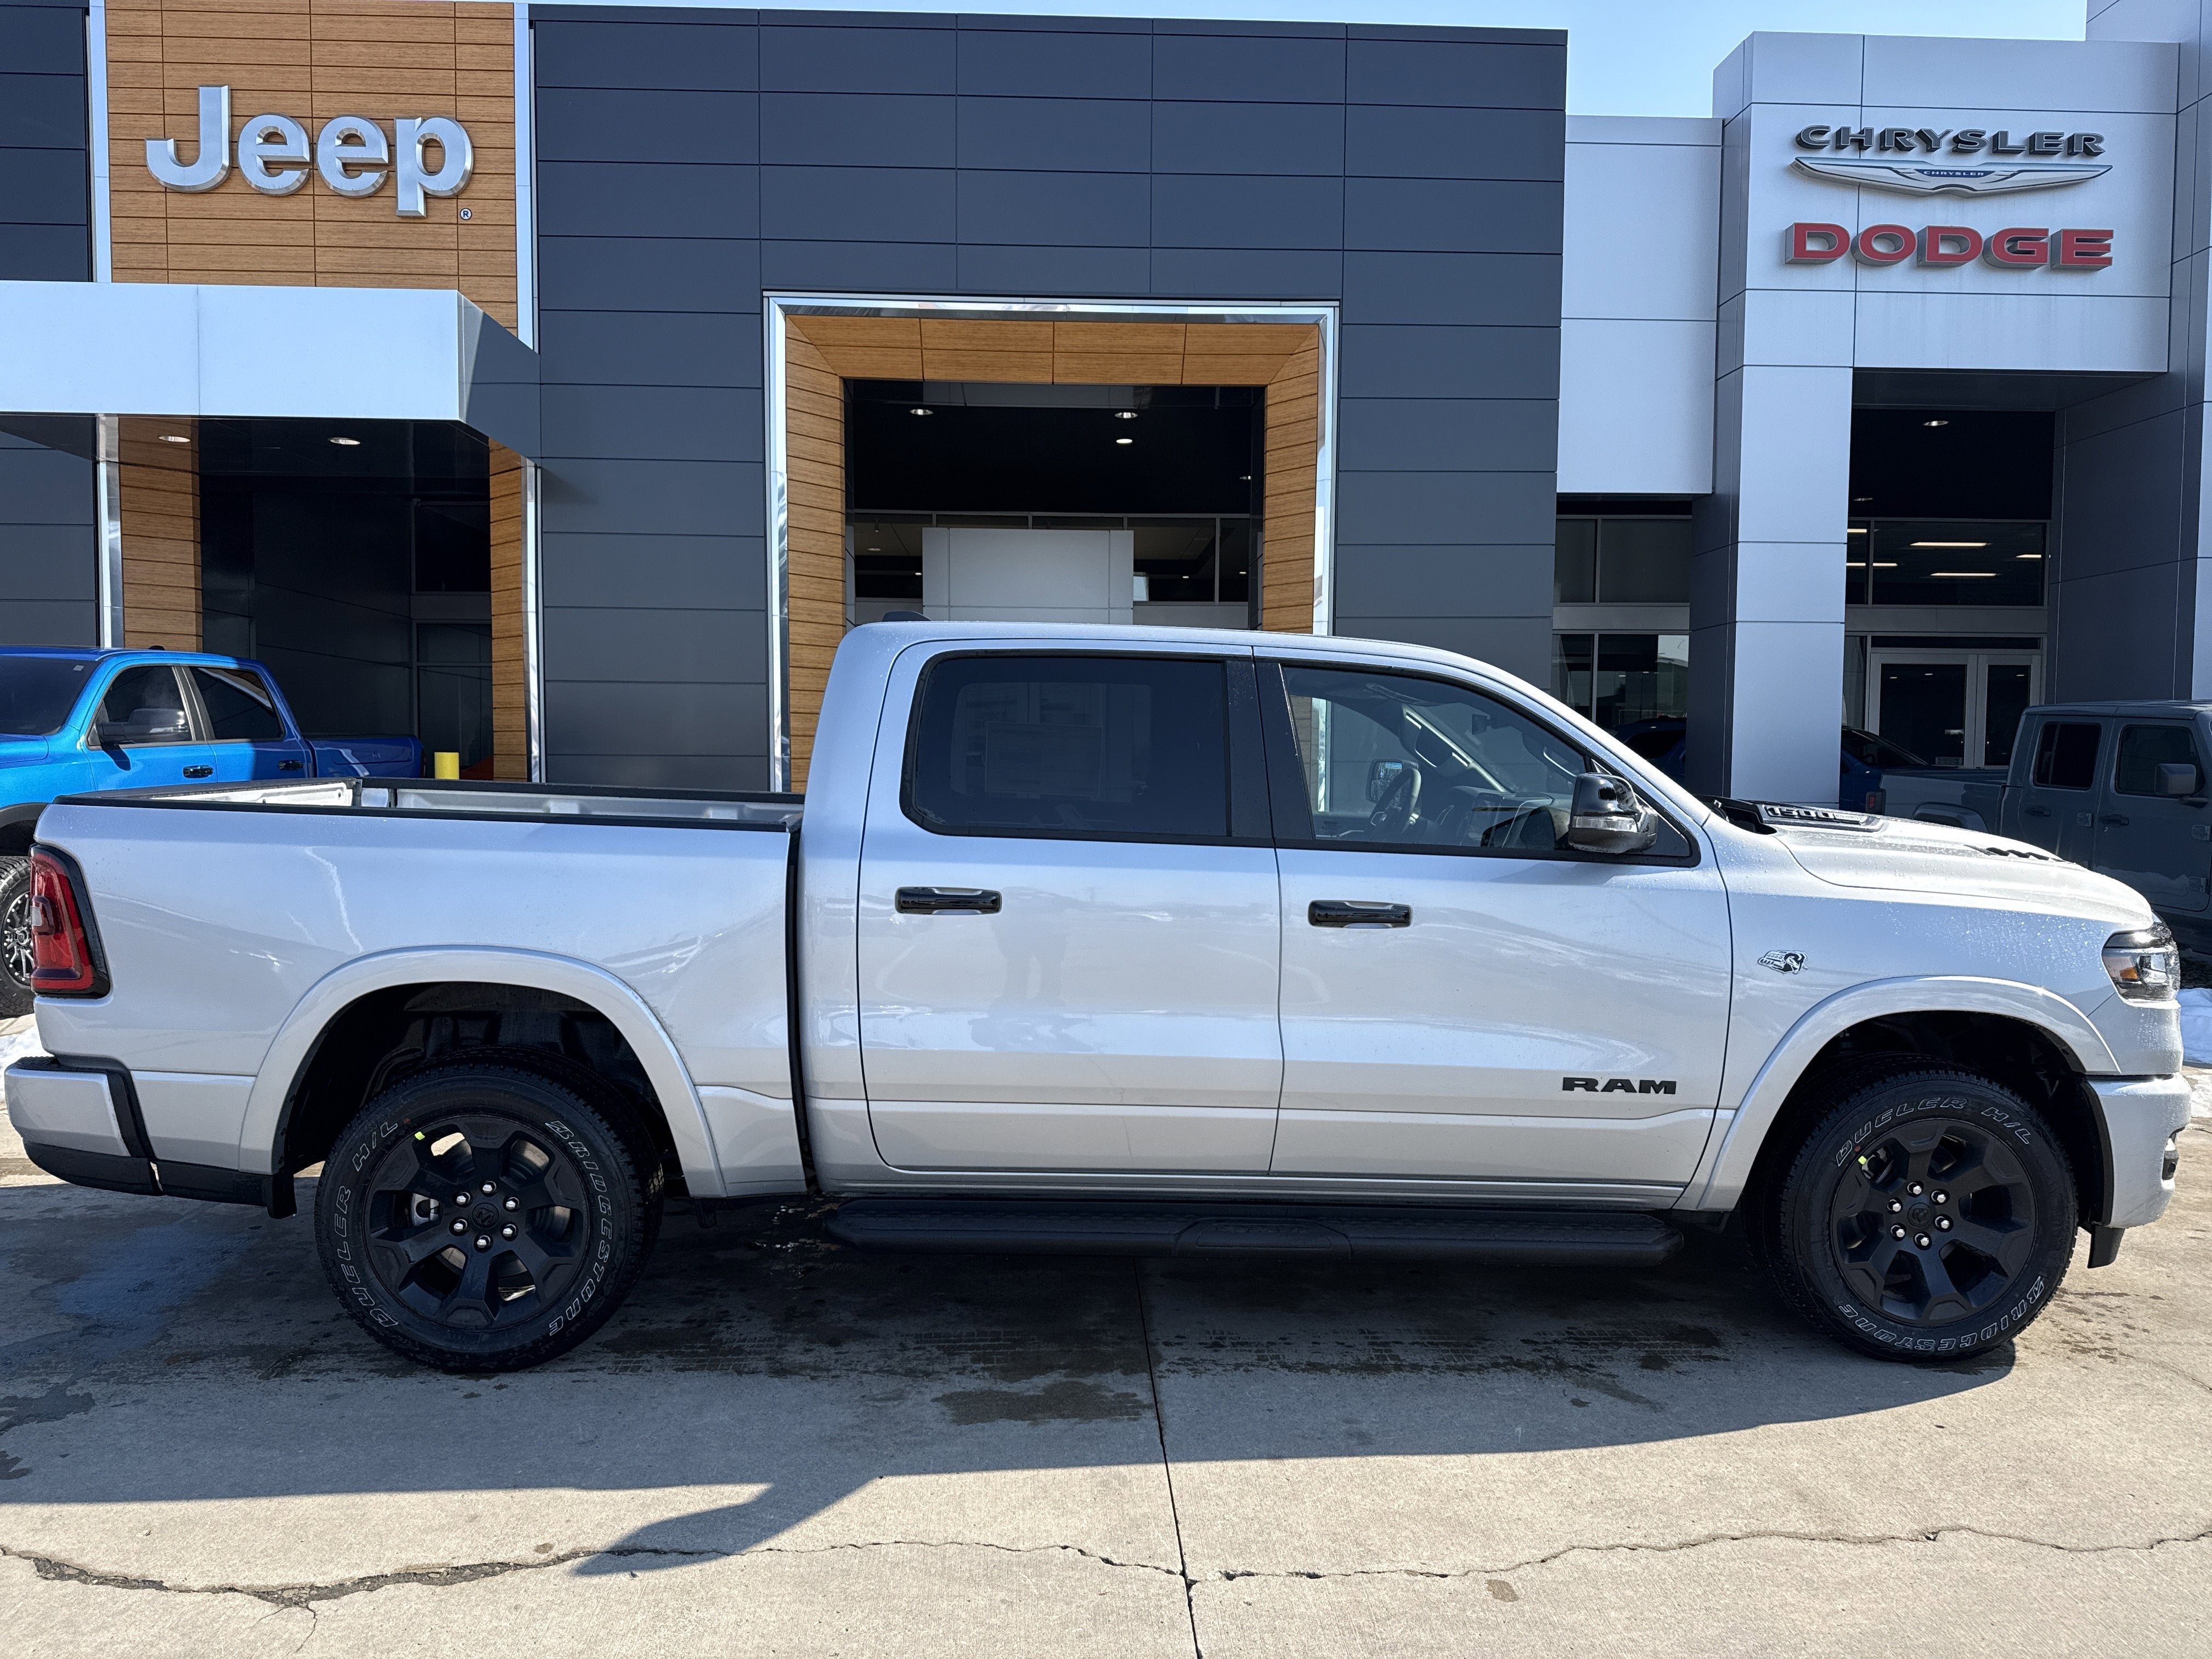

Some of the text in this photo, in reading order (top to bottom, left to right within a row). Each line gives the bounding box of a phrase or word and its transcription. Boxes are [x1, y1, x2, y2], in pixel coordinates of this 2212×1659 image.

[145, 84, 473, 218] Jeep
[1796, 125, 2106, 156] CHRYSLER
[1785, 222, 2114, 270] DODGE
[1767, 806, 1835, 820] 1500
[1562, 1077, 1677, 1094] RAM
[1836, 1097, 2033, 1167] DUELER H/L
[334, 1120, 399, 1329] DUELER H/L
[545, 1120, 613, 1337] BRIDGESTONE
[1838, 1276, 2045, 1352] BRIDGESTONE
